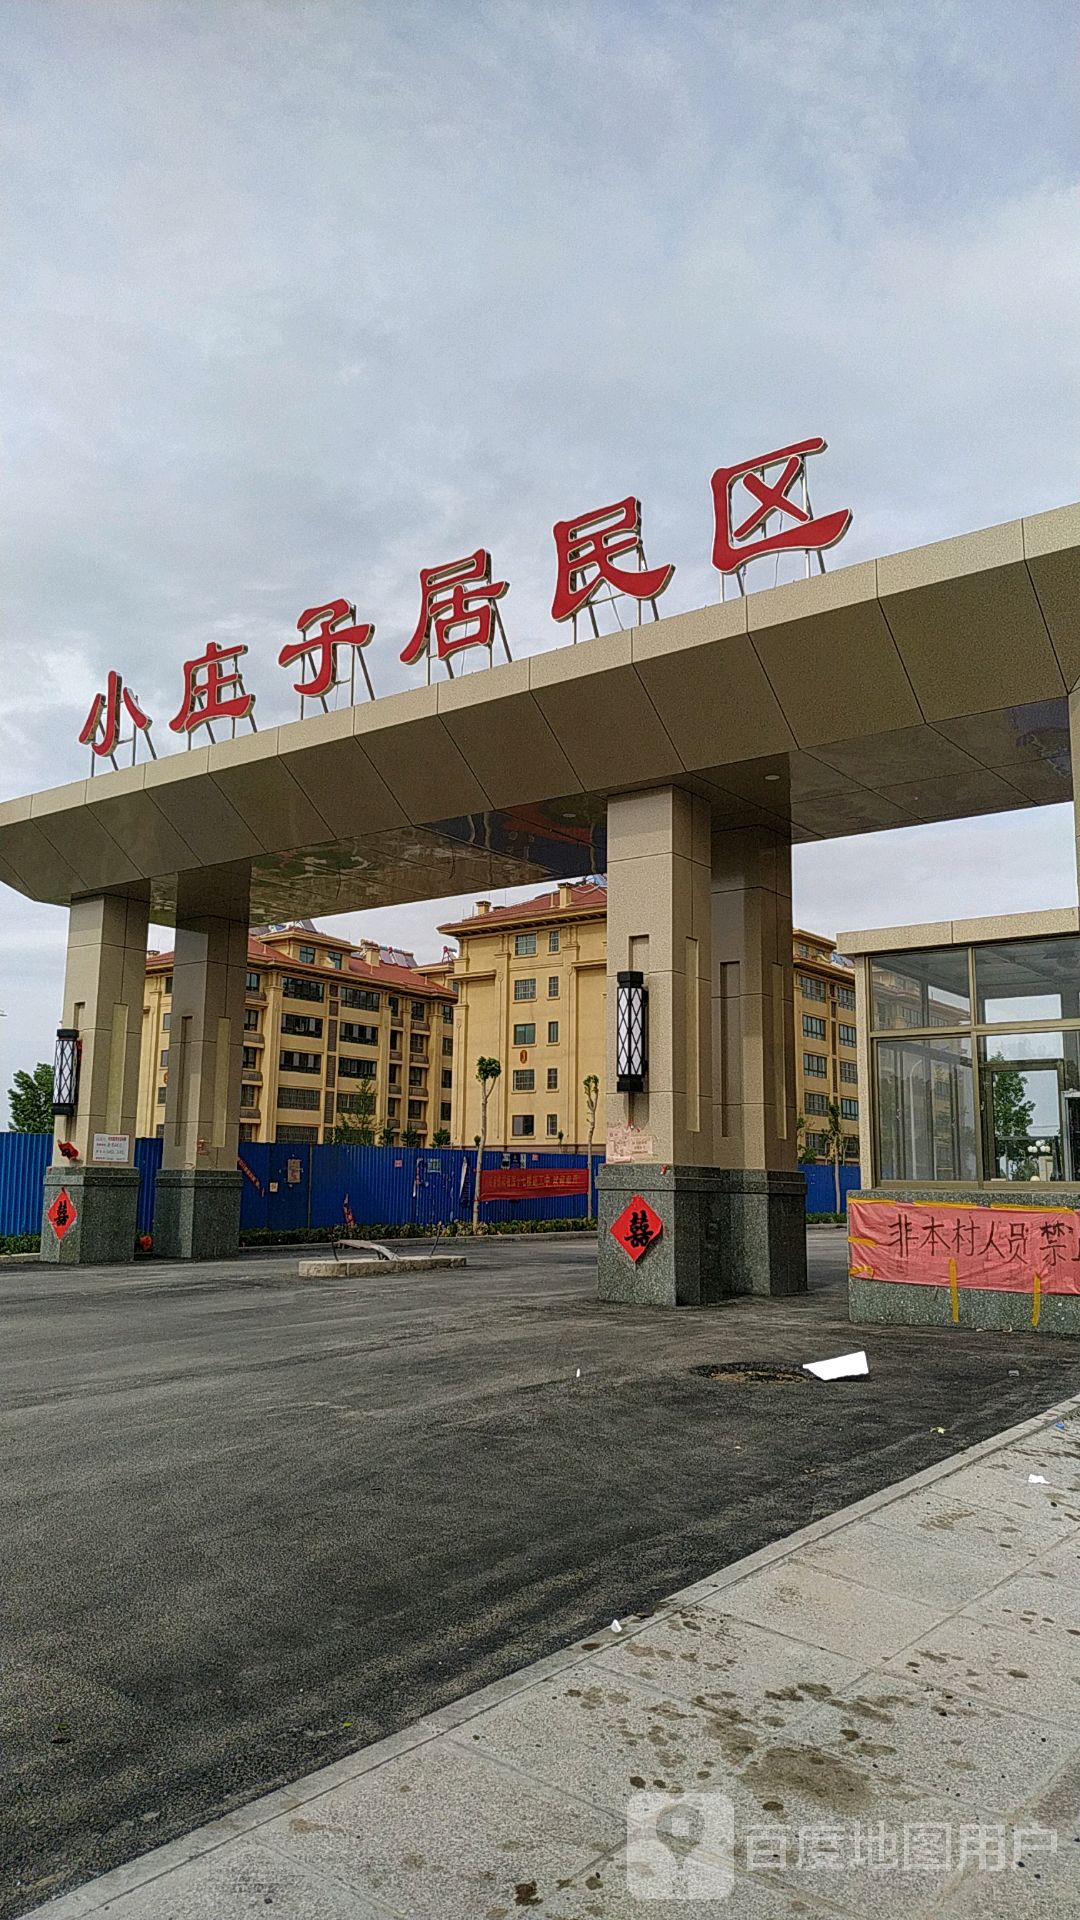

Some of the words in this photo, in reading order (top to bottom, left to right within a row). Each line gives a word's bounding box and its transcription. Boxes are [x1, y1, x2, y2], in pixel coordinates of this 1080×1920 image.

[78, 436, 853, 757] 小庄子居民区
[624, 1210, 654, 1248] 囍
